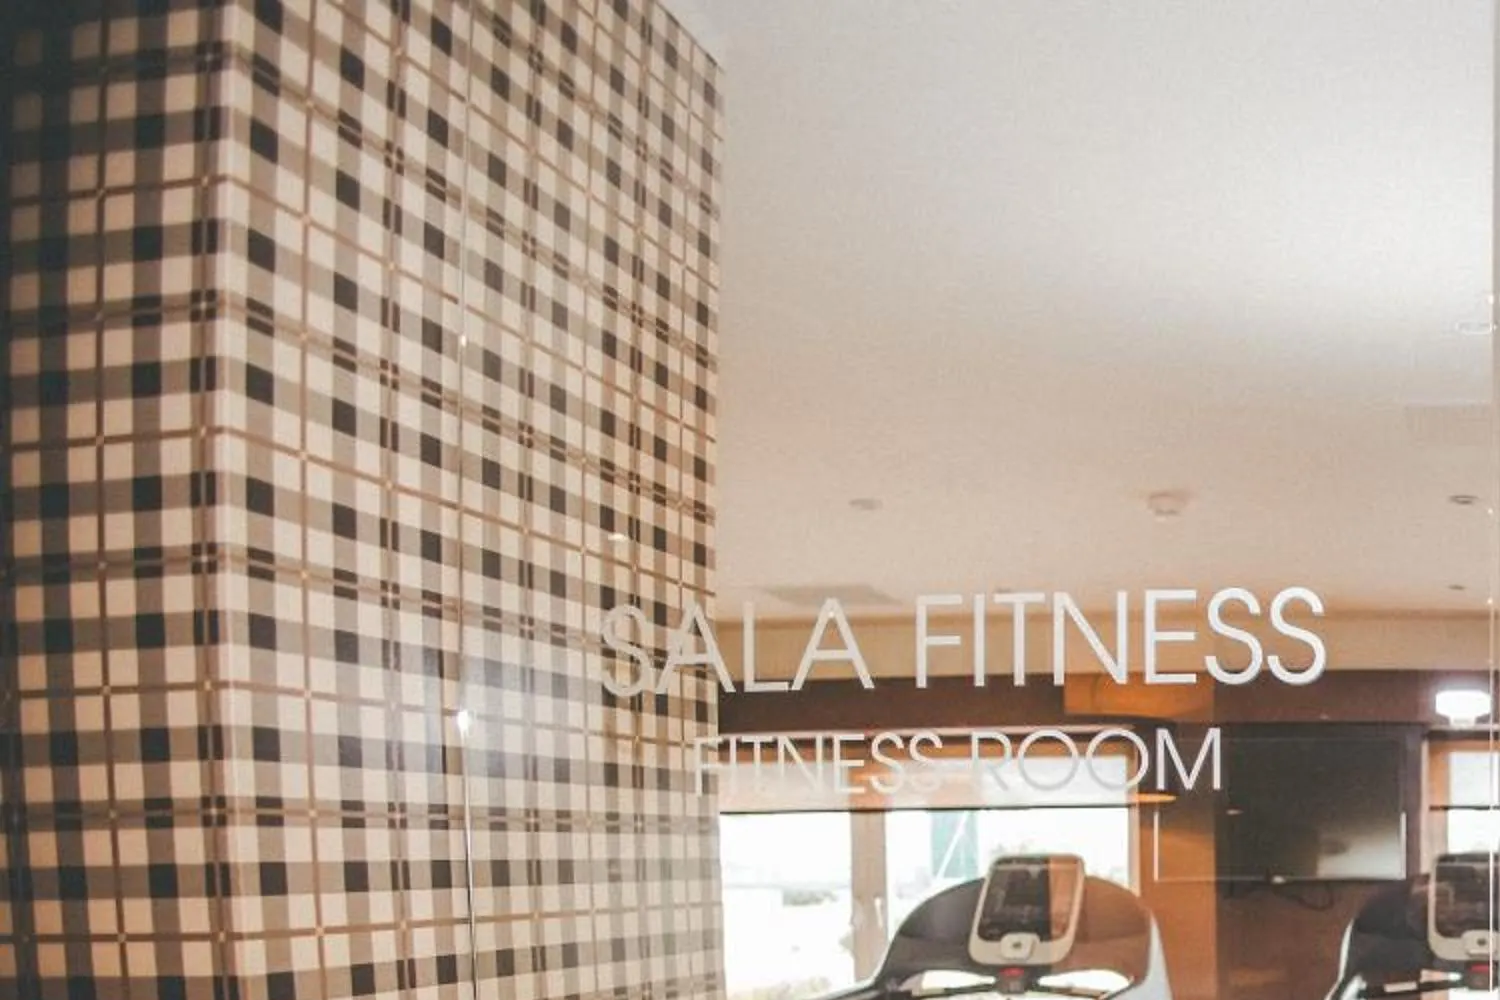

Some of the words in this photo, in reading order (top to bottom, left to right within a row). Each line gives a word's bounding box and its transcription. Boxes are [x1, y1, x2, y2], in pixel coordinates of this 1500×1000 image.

[600, 597, 875, 697] SALA
[915, 586, 1327, 687] FITNESS
[695, 732, 944, 796] FITNESS
[970, 727, 1221, 791] ROOM
